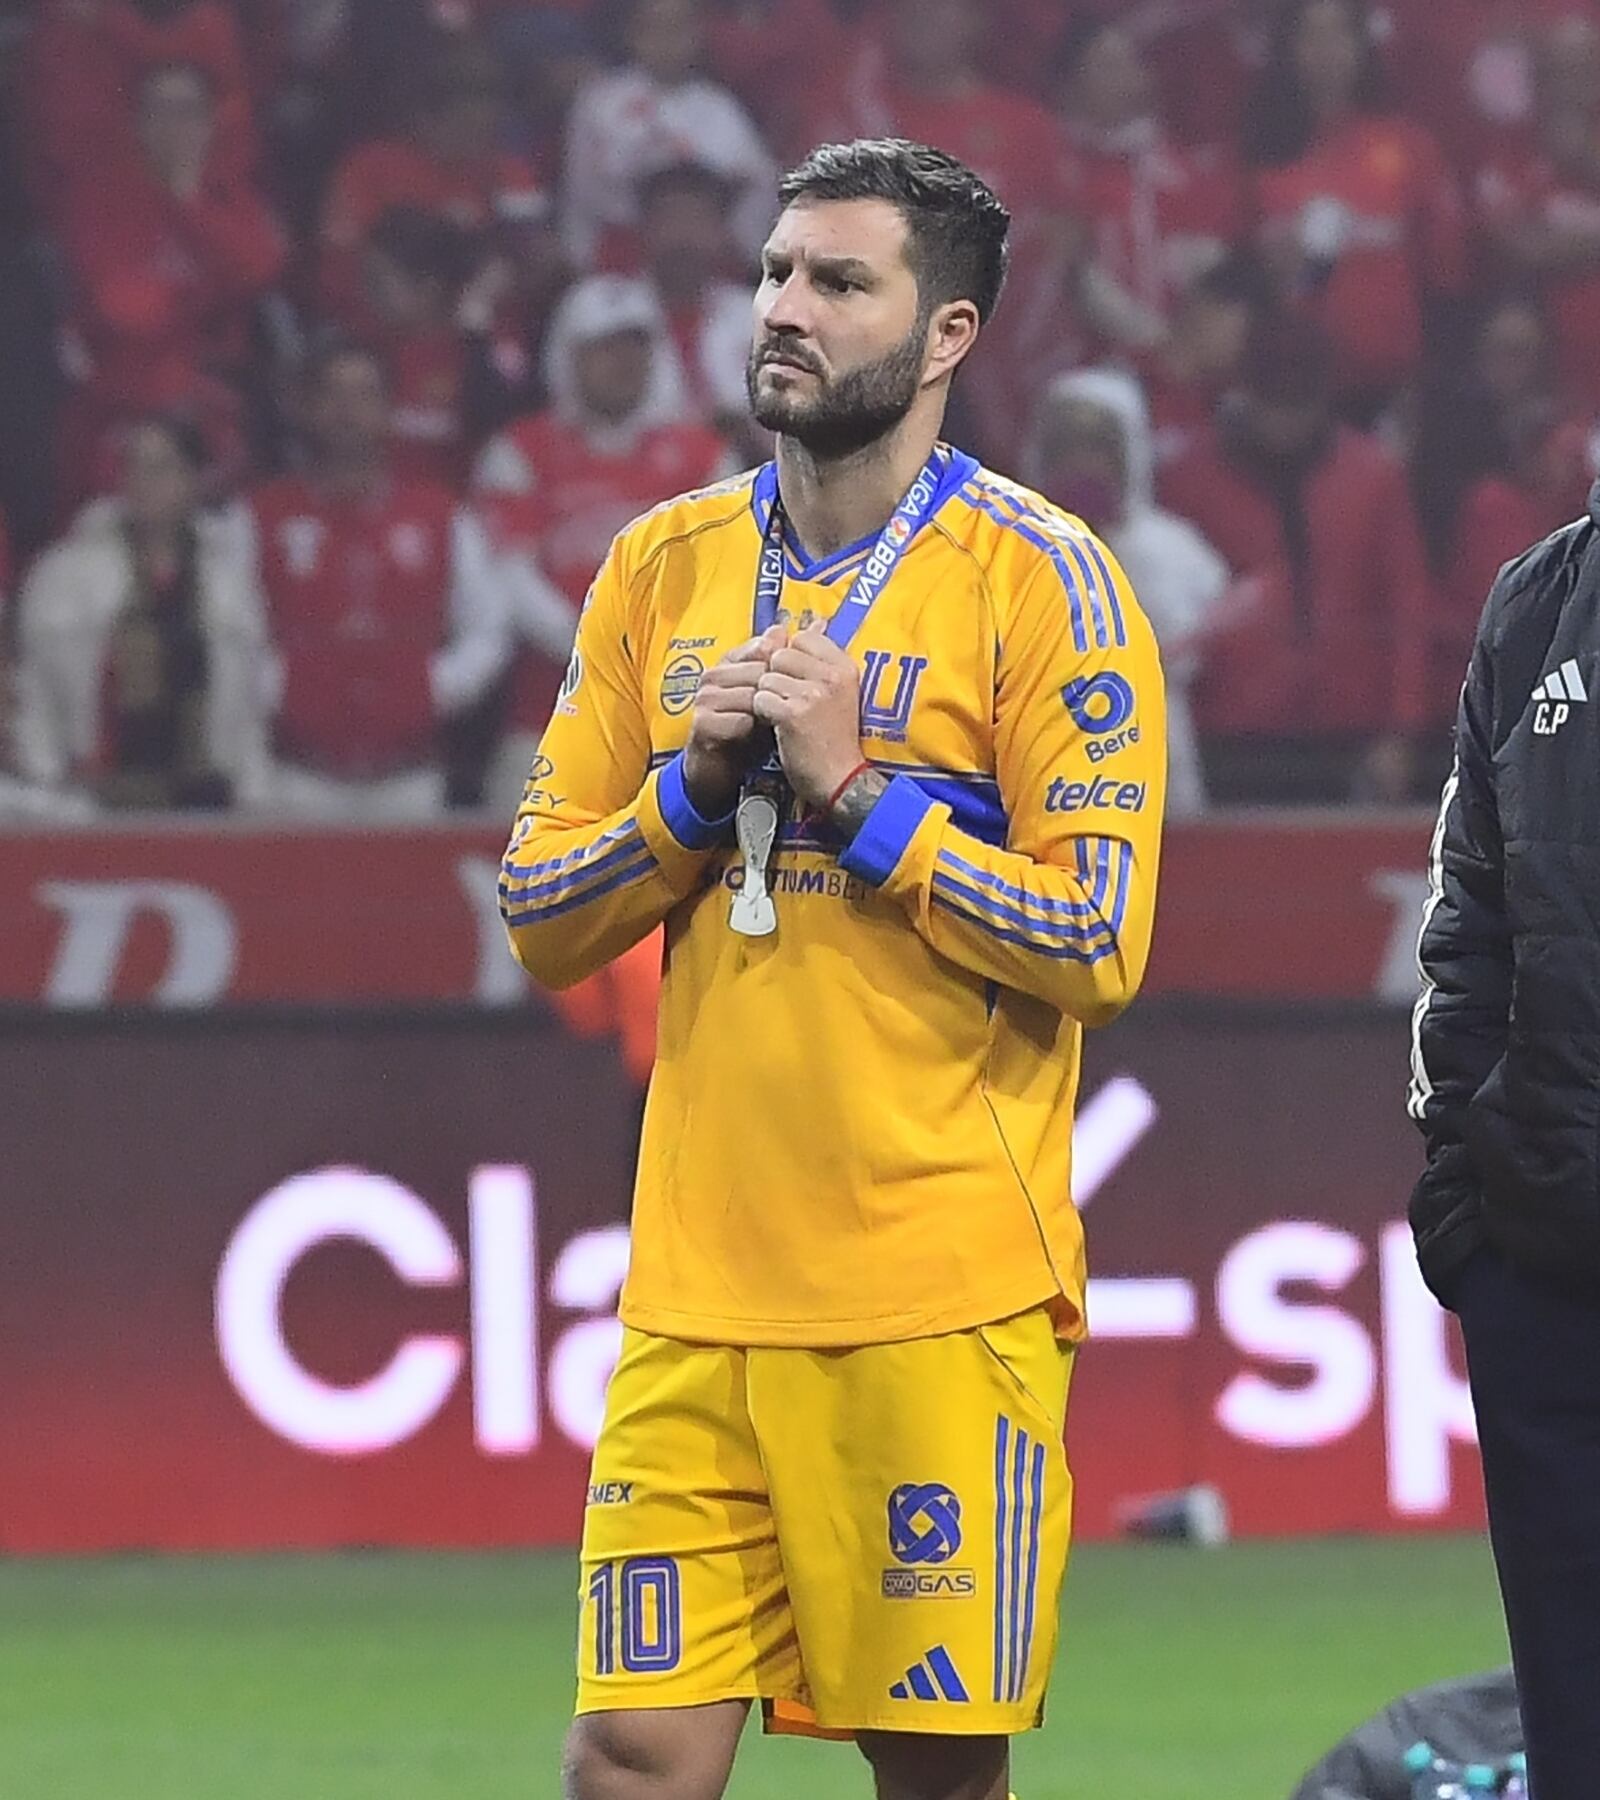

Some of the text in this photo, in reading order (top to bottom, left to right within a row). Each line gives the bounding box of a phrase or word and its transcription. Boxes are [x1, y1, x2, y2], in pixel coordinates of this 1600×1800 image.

[850, 466, 938, 607] LIGA BBVA
[758, 548, 782, 597] LIGA
[1044, 773, 1147, 813] telcel
[917, 1575, 974, 1593] GAS
[590, 1557, 680, 1675] 10
